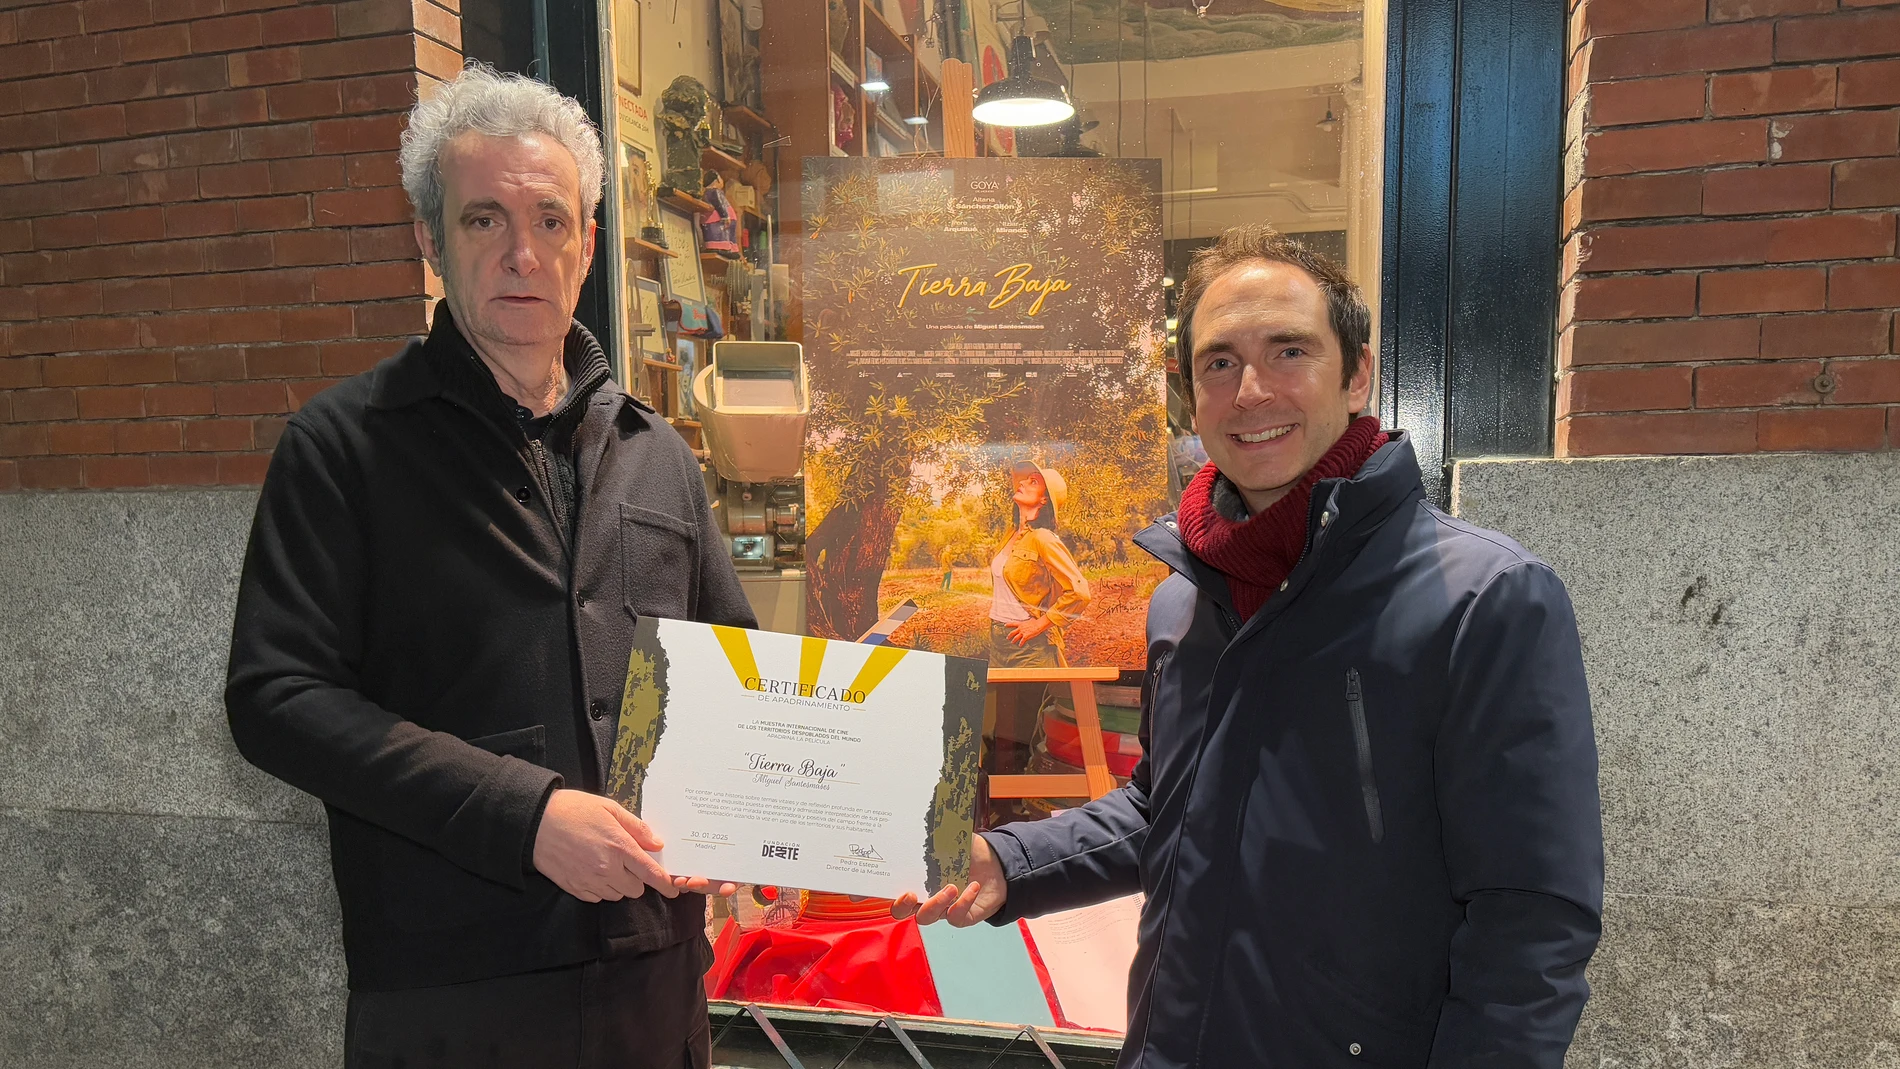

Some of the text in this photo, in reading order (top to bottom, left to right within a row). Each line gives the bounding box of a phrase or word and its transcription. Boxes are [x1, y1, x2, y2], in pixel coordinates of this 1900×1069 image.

[970, 180, 1000, 190] GOYA
[955, 202, 1014, 211] Sánchez-Gijón
[898, 262, 1072, 316] Tierra Baja
[744, 676, 867, 704] CERTIFICADO
[757, 694, 851, 712] DE APADRINAMIENTO
[760, 720, 786, 728] MUESTRA
[786, 723, 827, 732] INTERNACIONAL
[758, 725, 791, 735] TERRITORIOS
[791, 729, 830, 739] DESPOBLADOS
[842, 735, 861, 743] MUNDO
[767, 733, 795, 742] APADRINA
[752, 773, 831, 791] Miguel Santesmases
[692, 801, 719, 810] tagonistas
[762, 810, 801, 819] esperanzadora
[698, 809, 733, 818] despoblación
[721, 798, 744, 806] exquisita
[825, 810, 860, 820] interpretación
[831, 804, 855, 812] profunda
[712, 833, 729, 841] 2025
[840, 858, 879, 869] Pedro Estepa
[826, 864, 851, 872] Director
[866, 869, 891, 877] Muestra
